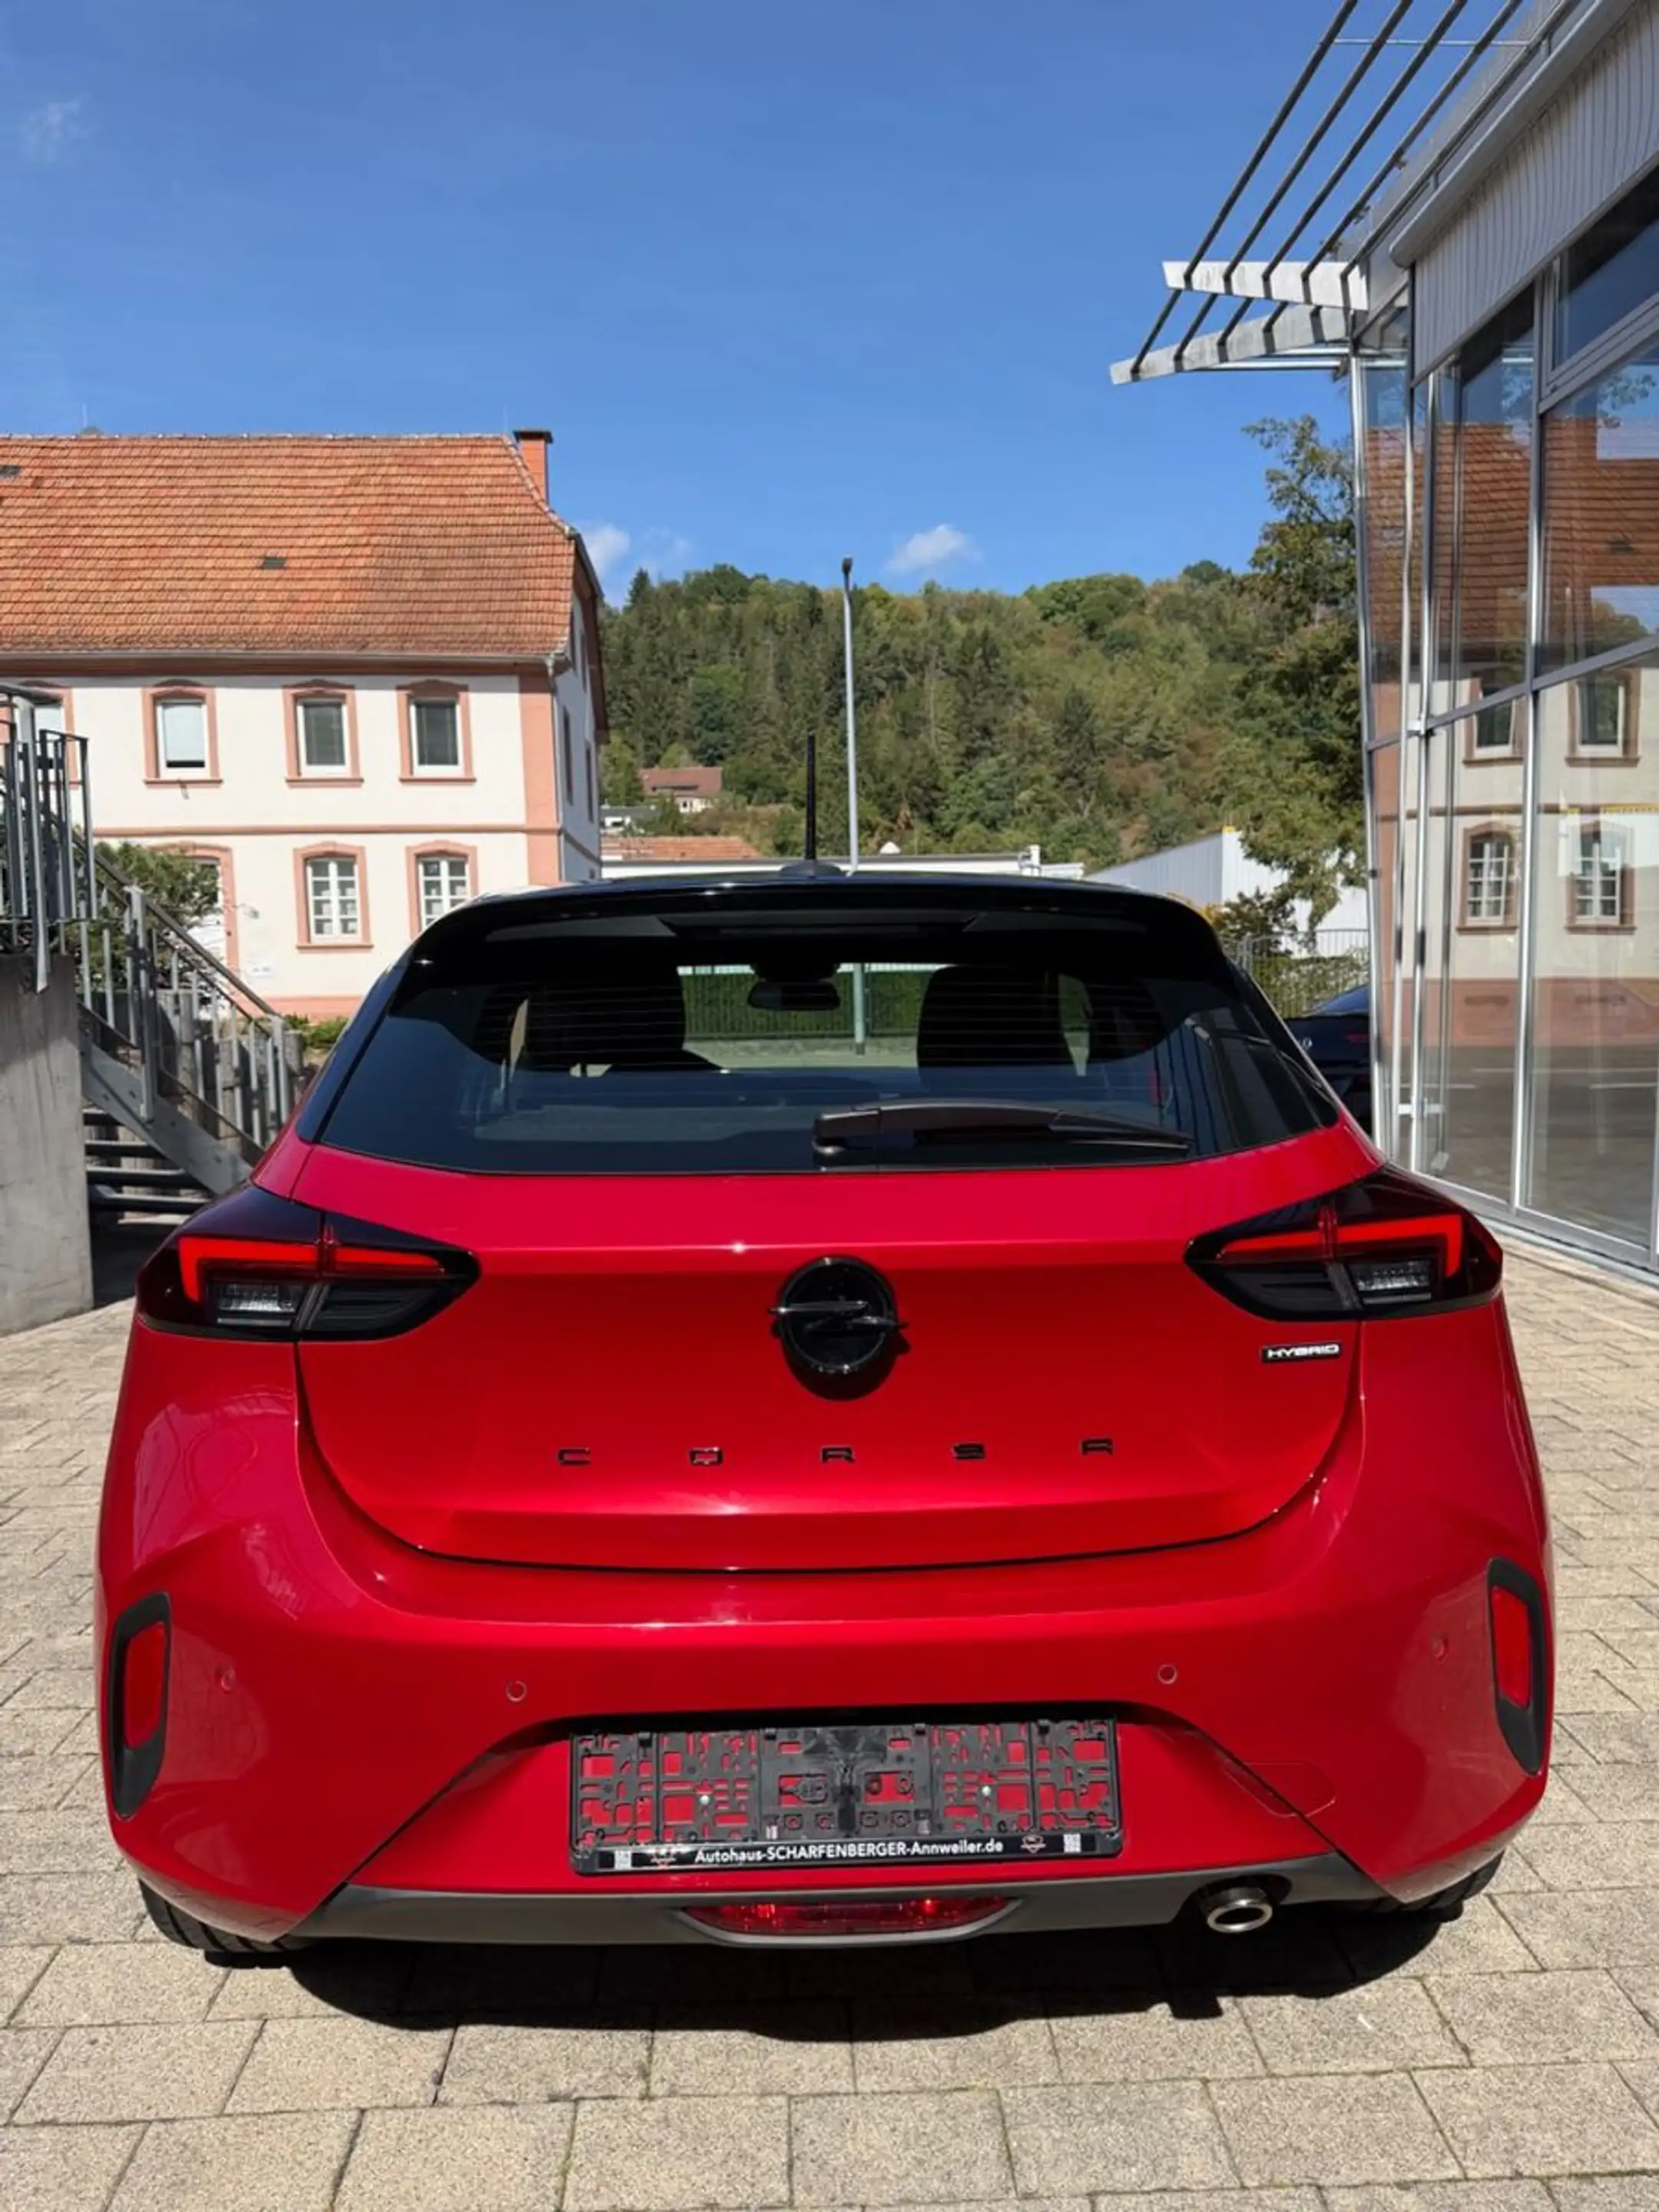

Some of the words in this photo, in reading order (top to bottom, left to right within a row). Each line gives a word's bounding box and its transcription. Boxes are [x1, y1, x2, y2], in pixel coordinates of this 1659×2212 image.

[1267, 1344, 1339, 1359] HYBRID
[558, 1439, 1114, 1465] CORSA
[694, 1838, 1005, 1864] Autohaus-SCHARFENBERGER-Annweiler.de
